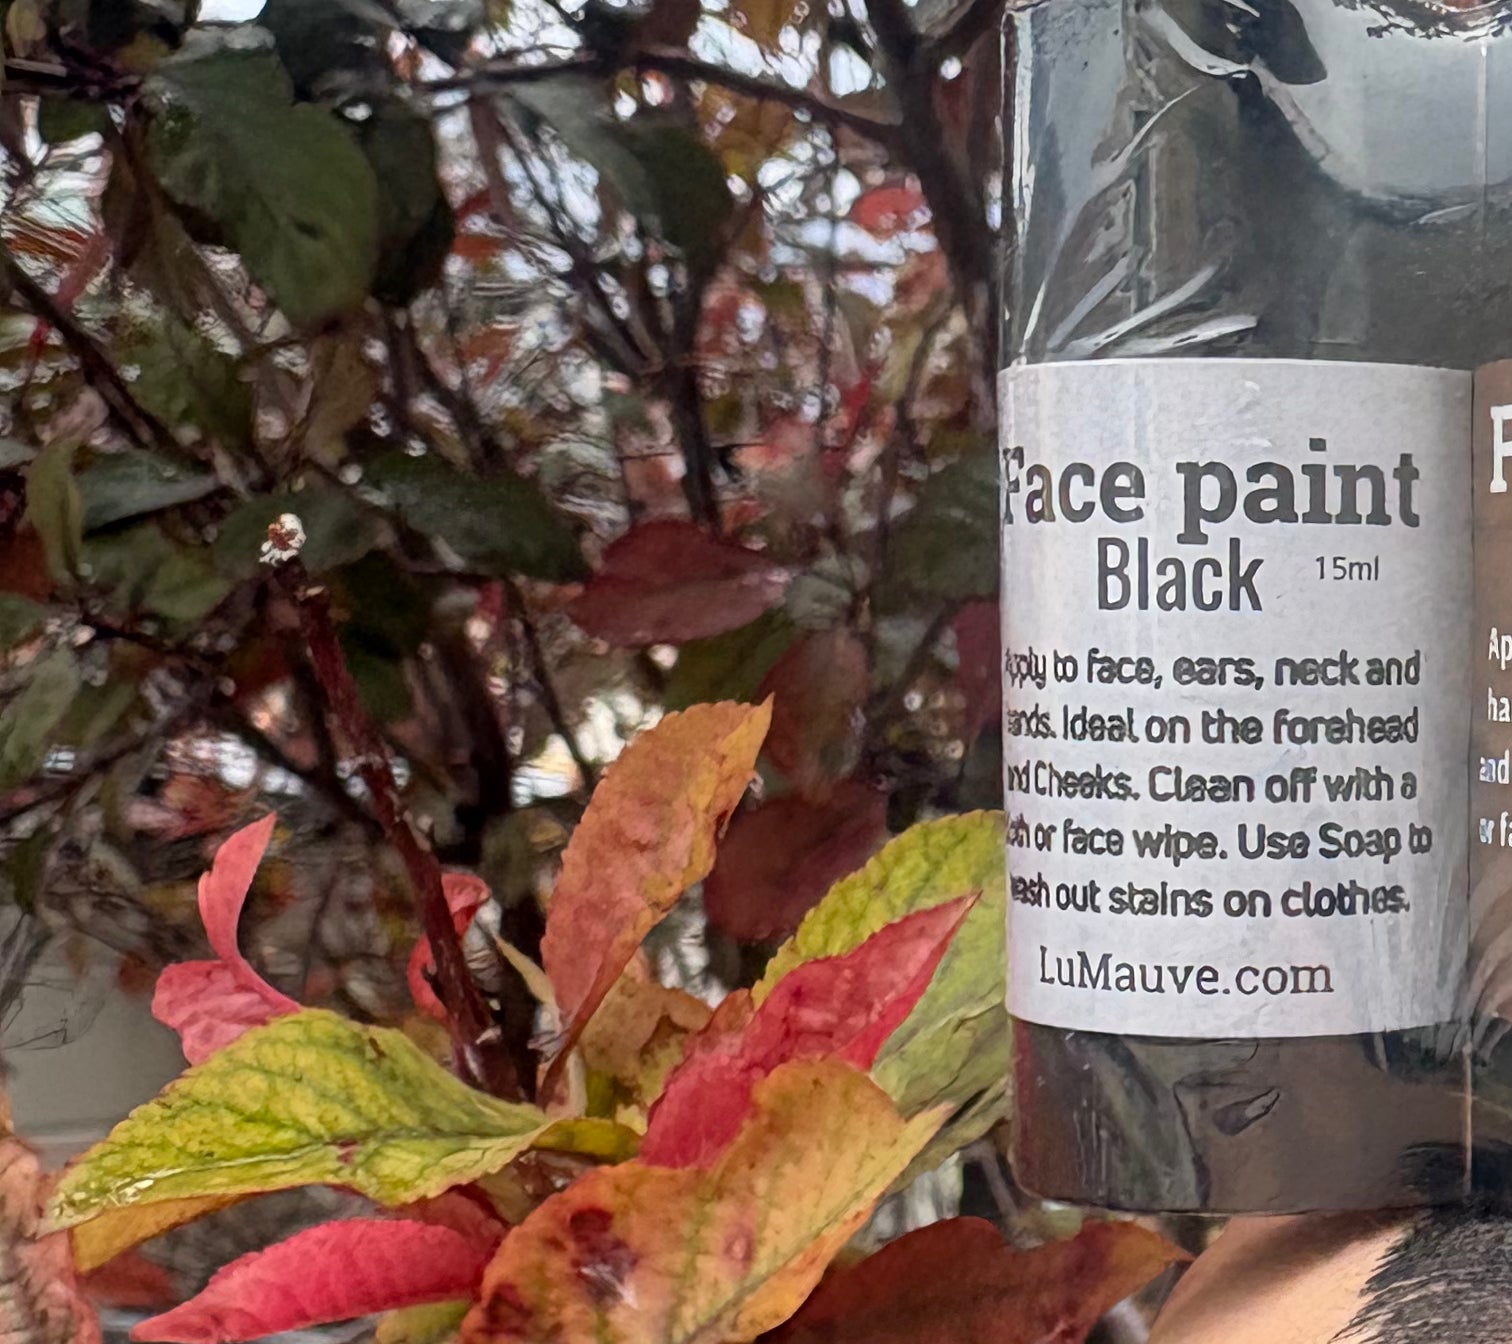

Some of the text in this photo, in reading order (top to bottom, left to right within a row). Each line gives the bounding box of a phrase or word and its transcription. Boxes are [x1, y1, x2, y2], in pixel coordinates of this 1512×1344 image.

[1002, 439, 1420, 545] Face paint
[1098, 537, 1379, 612] Black 15ml
[1053, 649, 1078, 683] to
[1087, 647, 1162, 689] face,
[1173, 657, 1264, 690] ears,
[1275, 649, 1360, 686] neck
[1365, 649, 1420, 686] and
[1062, 704, 1139, 743] Ideal
[1145, 715, 1190, 744] on
[1201, 708, 1263, 744] the
[1273, 706, 1419, 744] forehead
[1007, 759, 1417, 803] nd Cheeks. Clean off with a
[1034, 823, 1057, 852] or
[1063, 818, 1124, 856] face
[1132, 823, 1228, 867] wipe.
[1238, 823, 1310, 859] Use
[1319, 822, 1401, 864] Soap
[1408, 822, 1432, 854] to
[1056, 880, 1101, 913] out
[1108, 881, 1213, 917] stains
[1223, 889, 1272, 917] on
[1281, 879, 1410, 918] clothes.
[1040, 945, 1334, 996] LuMauve.com
